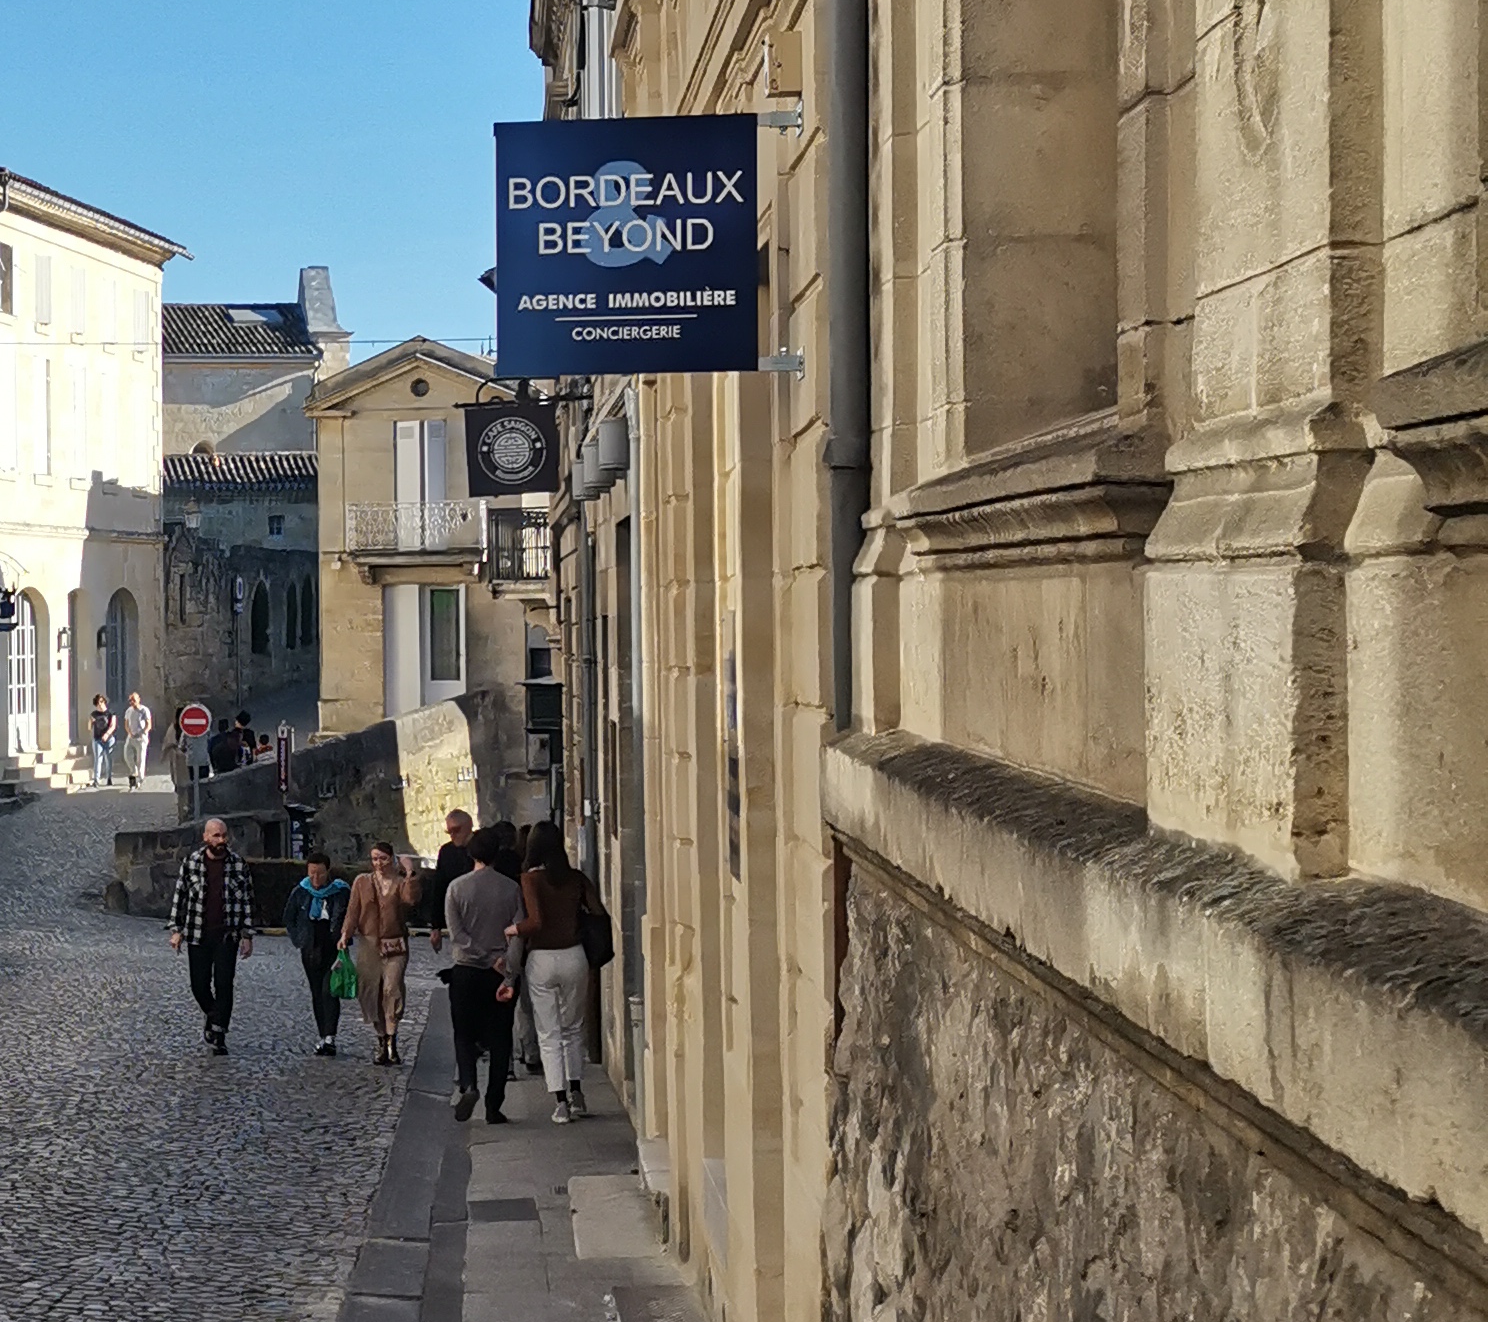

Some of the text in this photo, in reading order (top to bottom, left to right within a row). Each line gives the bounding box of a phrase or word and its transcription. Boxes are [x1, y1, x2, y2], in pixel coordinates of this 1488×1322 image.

[508, 170, 744, 210] BORDEAUX
[538, 218, 715, 255] BEYOND
[517, 286, 737, 311] AGENCE IMMOBILIÈRE
[571, 325, 682, 341] CONCIERGERIE
[503, 420, 538, 440] SAIGON
